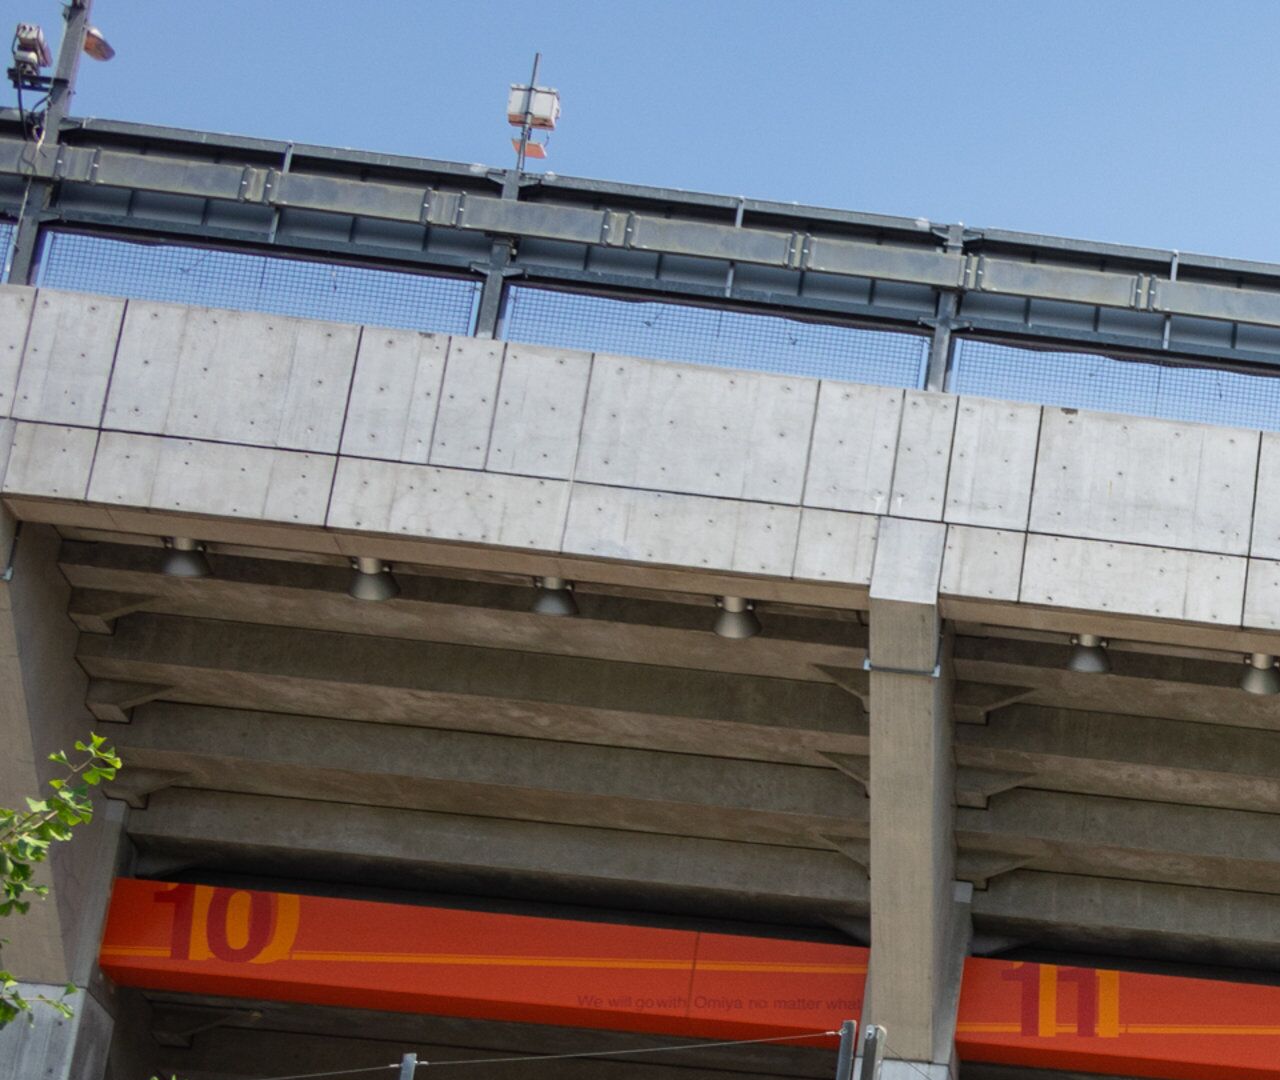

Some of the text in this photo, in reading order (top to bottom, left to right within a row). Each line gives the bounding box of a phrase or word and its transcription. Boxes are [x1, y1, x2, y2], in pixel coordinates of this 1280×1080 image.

[154, 883, 280, 964] 10
[577, 995, 603, 1008] We
[694, 995, 742, 1012] Omiya
[1001, 962, 1107, 1037] 11
